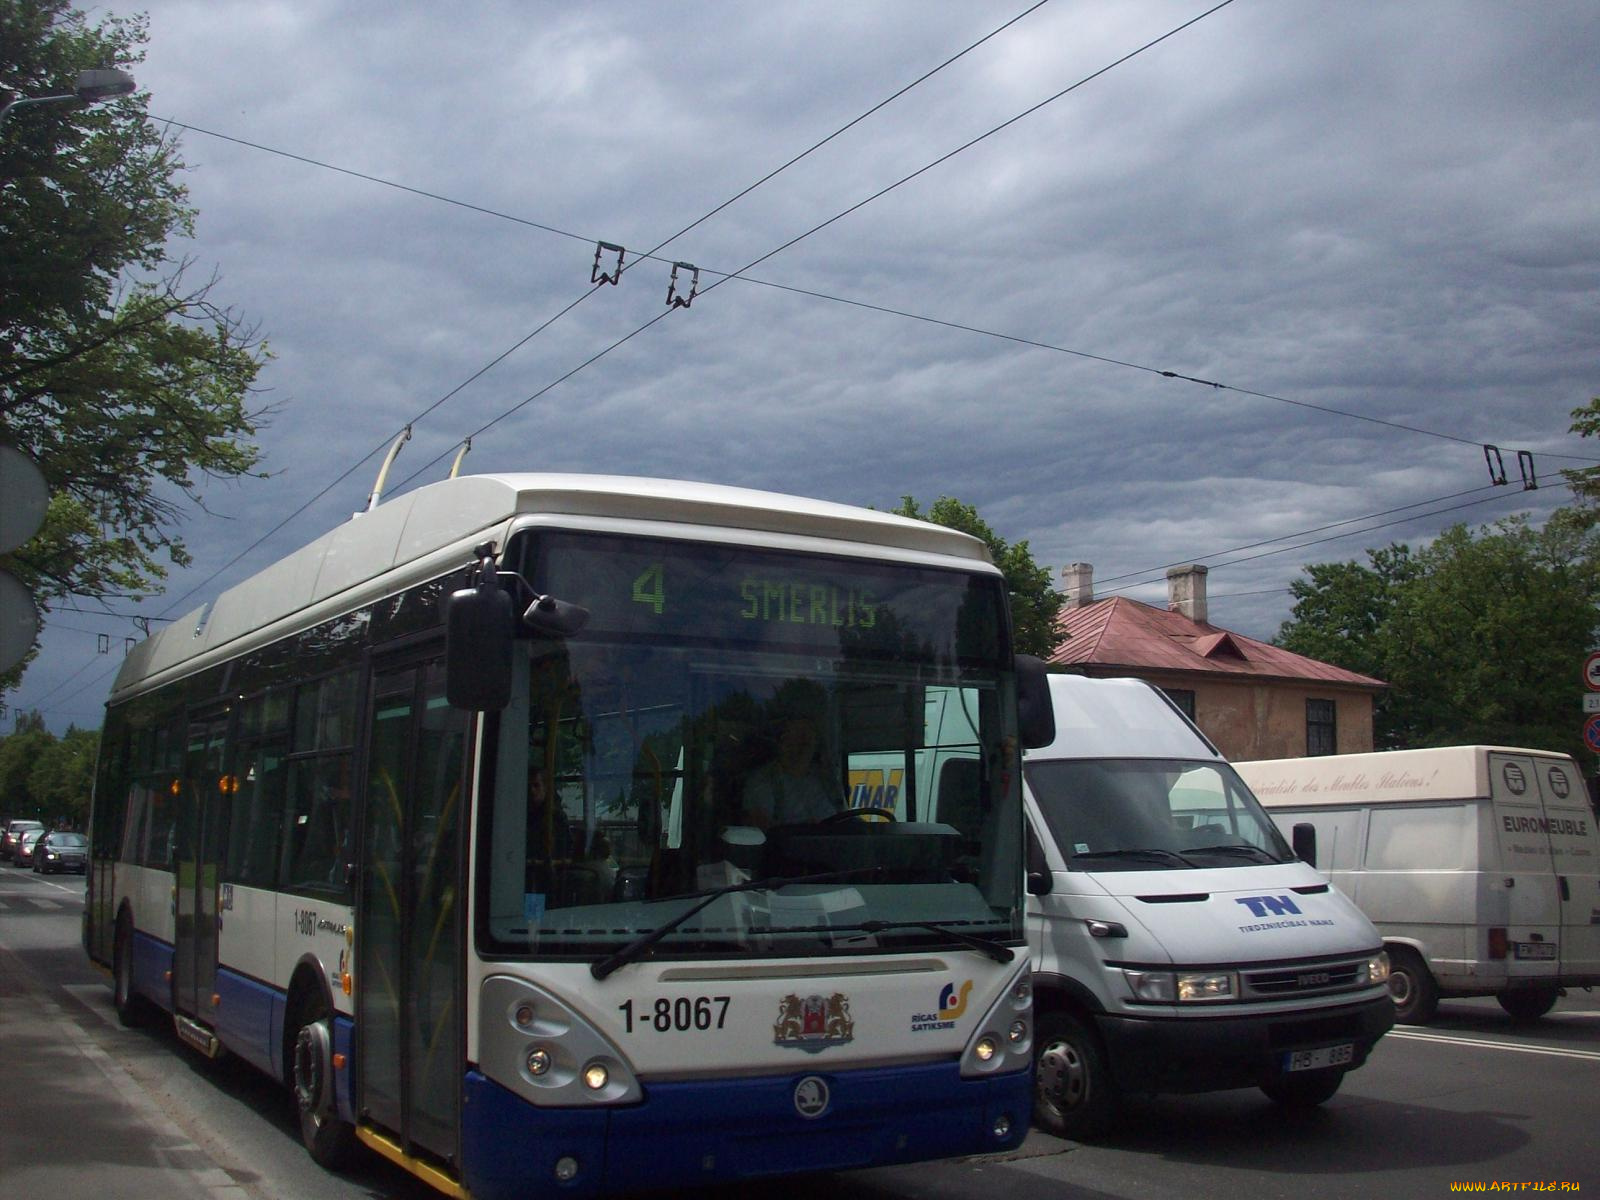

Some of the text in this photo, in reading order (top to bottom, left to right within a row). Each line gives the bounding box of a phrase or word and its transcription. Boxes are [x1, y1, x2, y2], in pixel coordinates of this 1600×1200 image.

[633, 563, 664, 614] 4
[1503, 815, 1588, 836] EUROMEUBLE
[1234, 895, 1303, 917] TN
[295, 908, 317, 937] 1-8067
[618, 996, 732, 1033] 1-8067
[911, 1021, 955, 1032] SATIKSME
